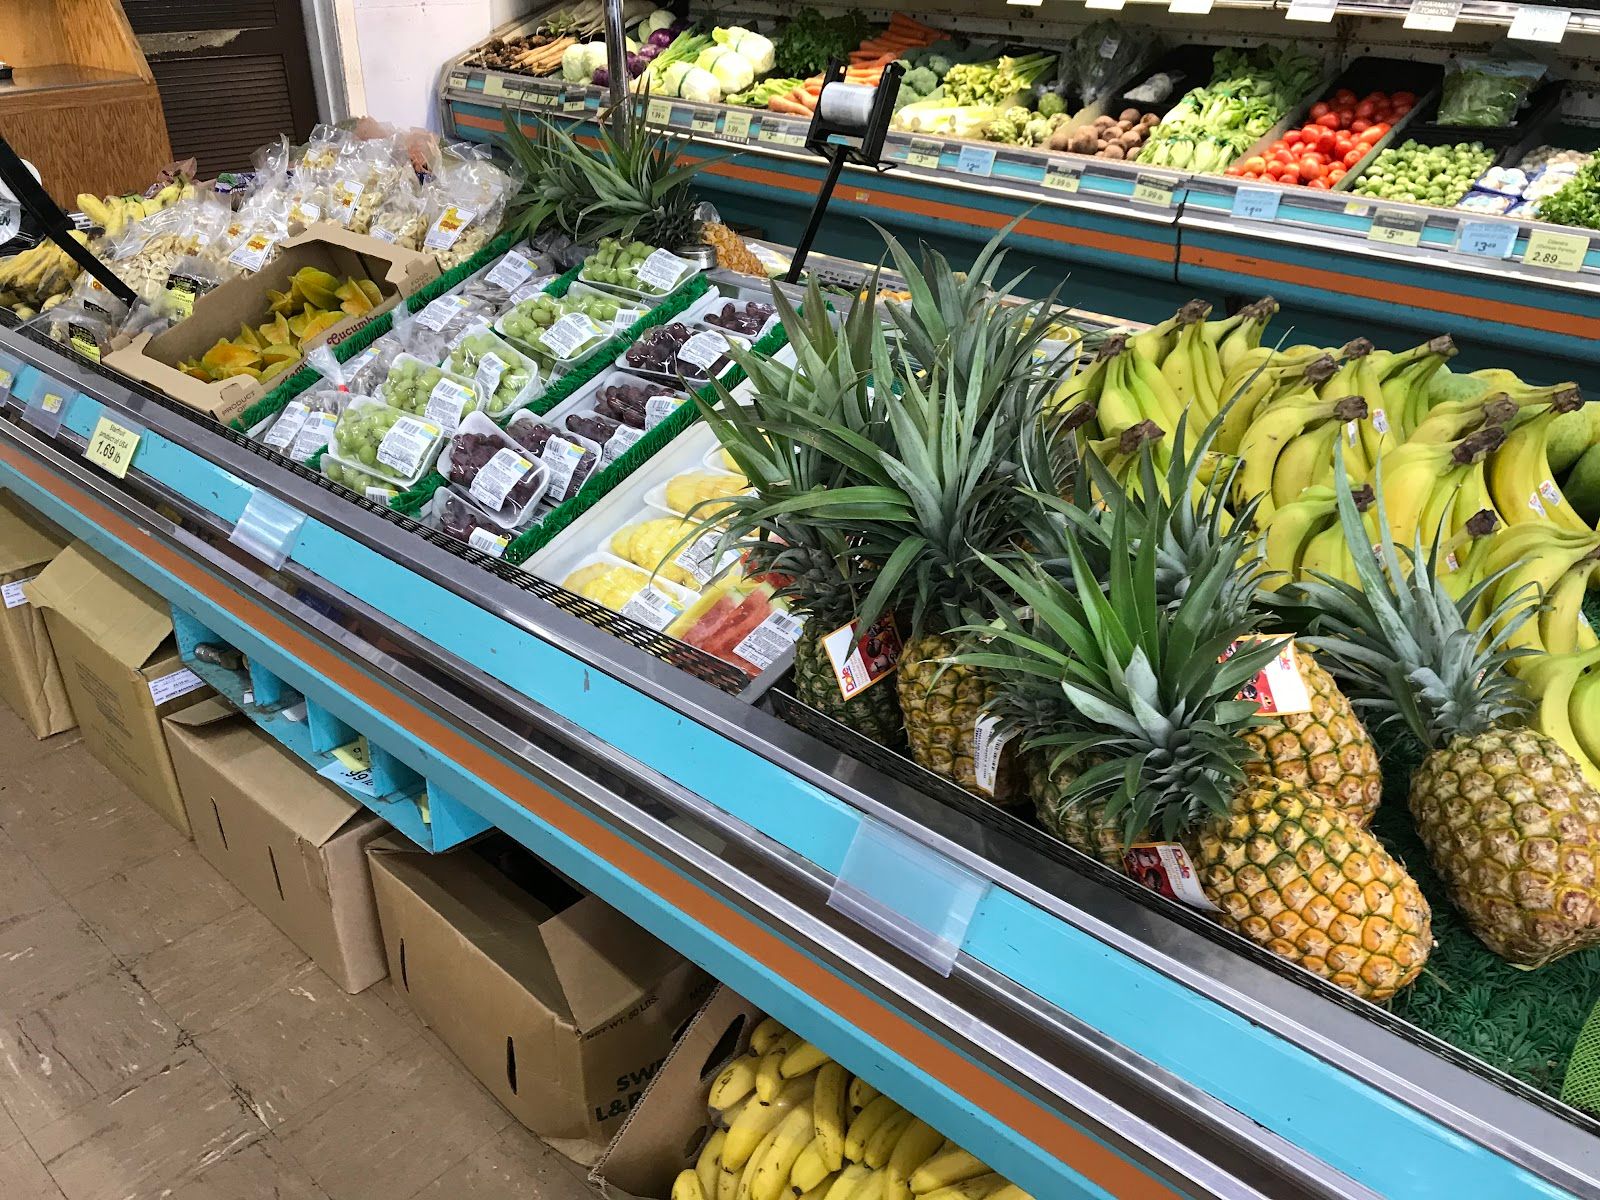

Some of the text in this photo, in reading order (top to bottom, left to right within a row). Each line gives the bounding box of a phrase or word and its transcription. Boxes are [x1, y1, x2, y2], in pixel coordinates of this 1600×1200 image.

[1532, 251, 1558, 264] 2.89
[327, 314, 380, 345] Cucumb
[221, 389, 256, 416] PRODUCT
[96, 440, 121, 464] 1.69 lb
[841, 664, 856, 694] Dole
[1171, 848, 1190, 879] Dole
